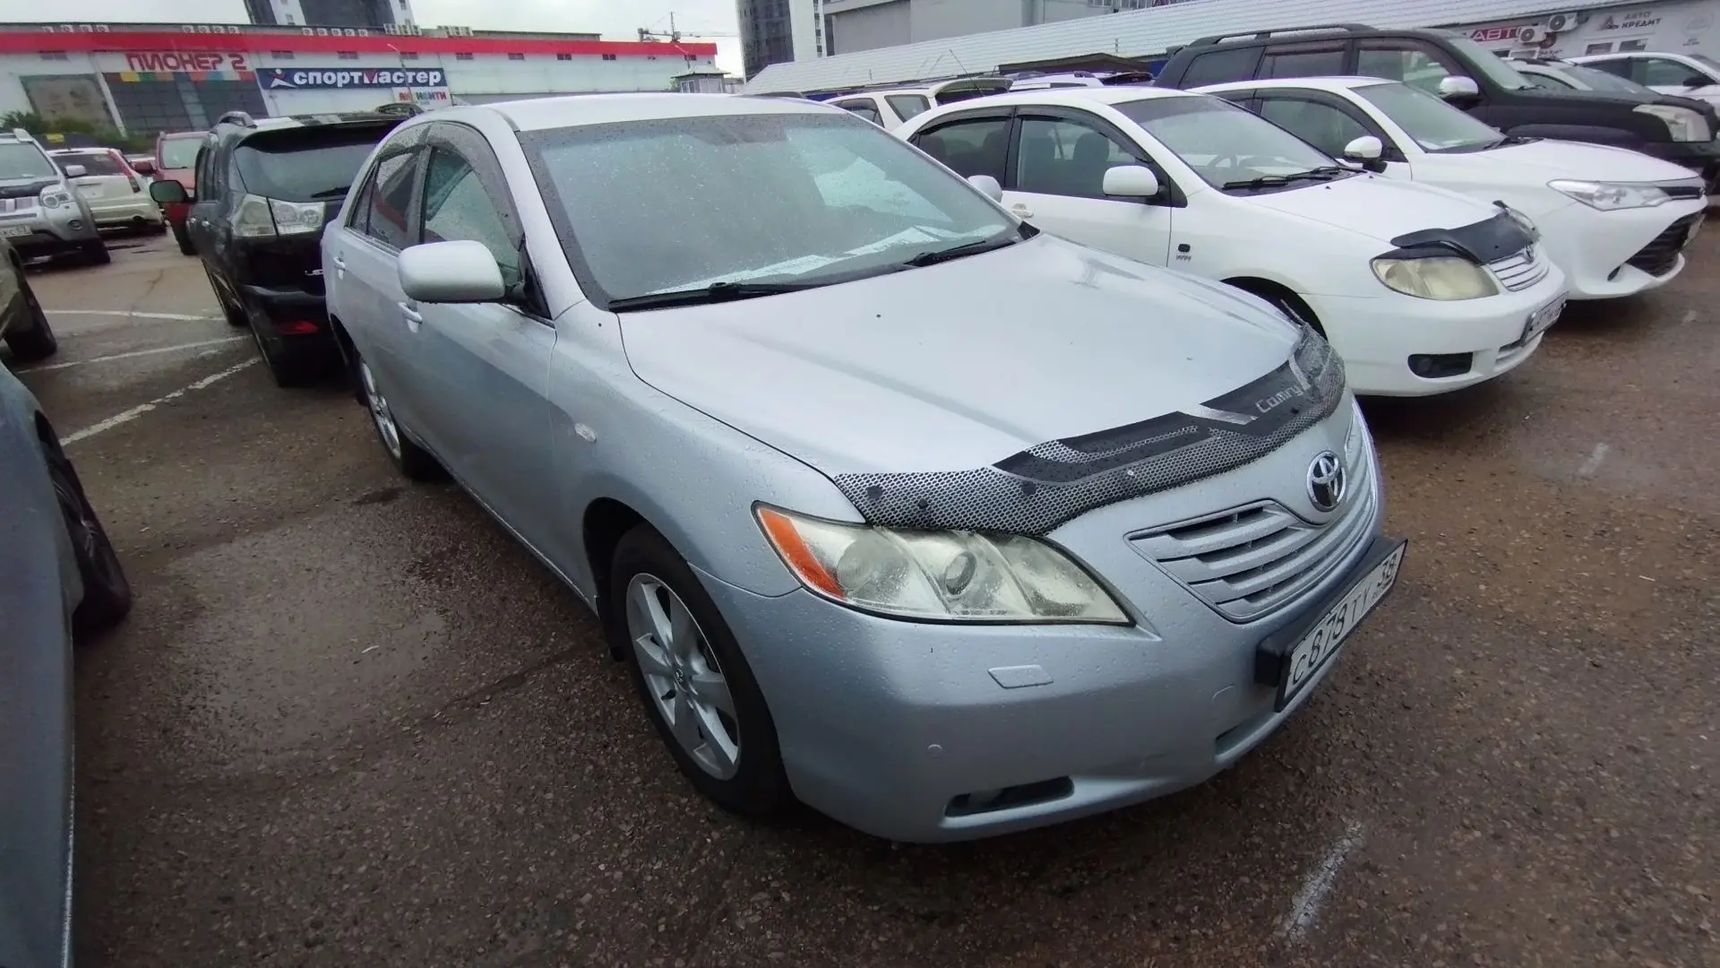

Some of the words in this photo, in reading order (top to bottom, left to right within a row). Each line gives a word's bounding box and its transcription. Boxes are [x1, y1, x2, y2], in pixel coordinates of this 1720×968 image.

[125, 53, 224, 71] ПИОНЕР
[227, 53, 248, 71] 2
[1255, 385, 1304, 413] Camry
